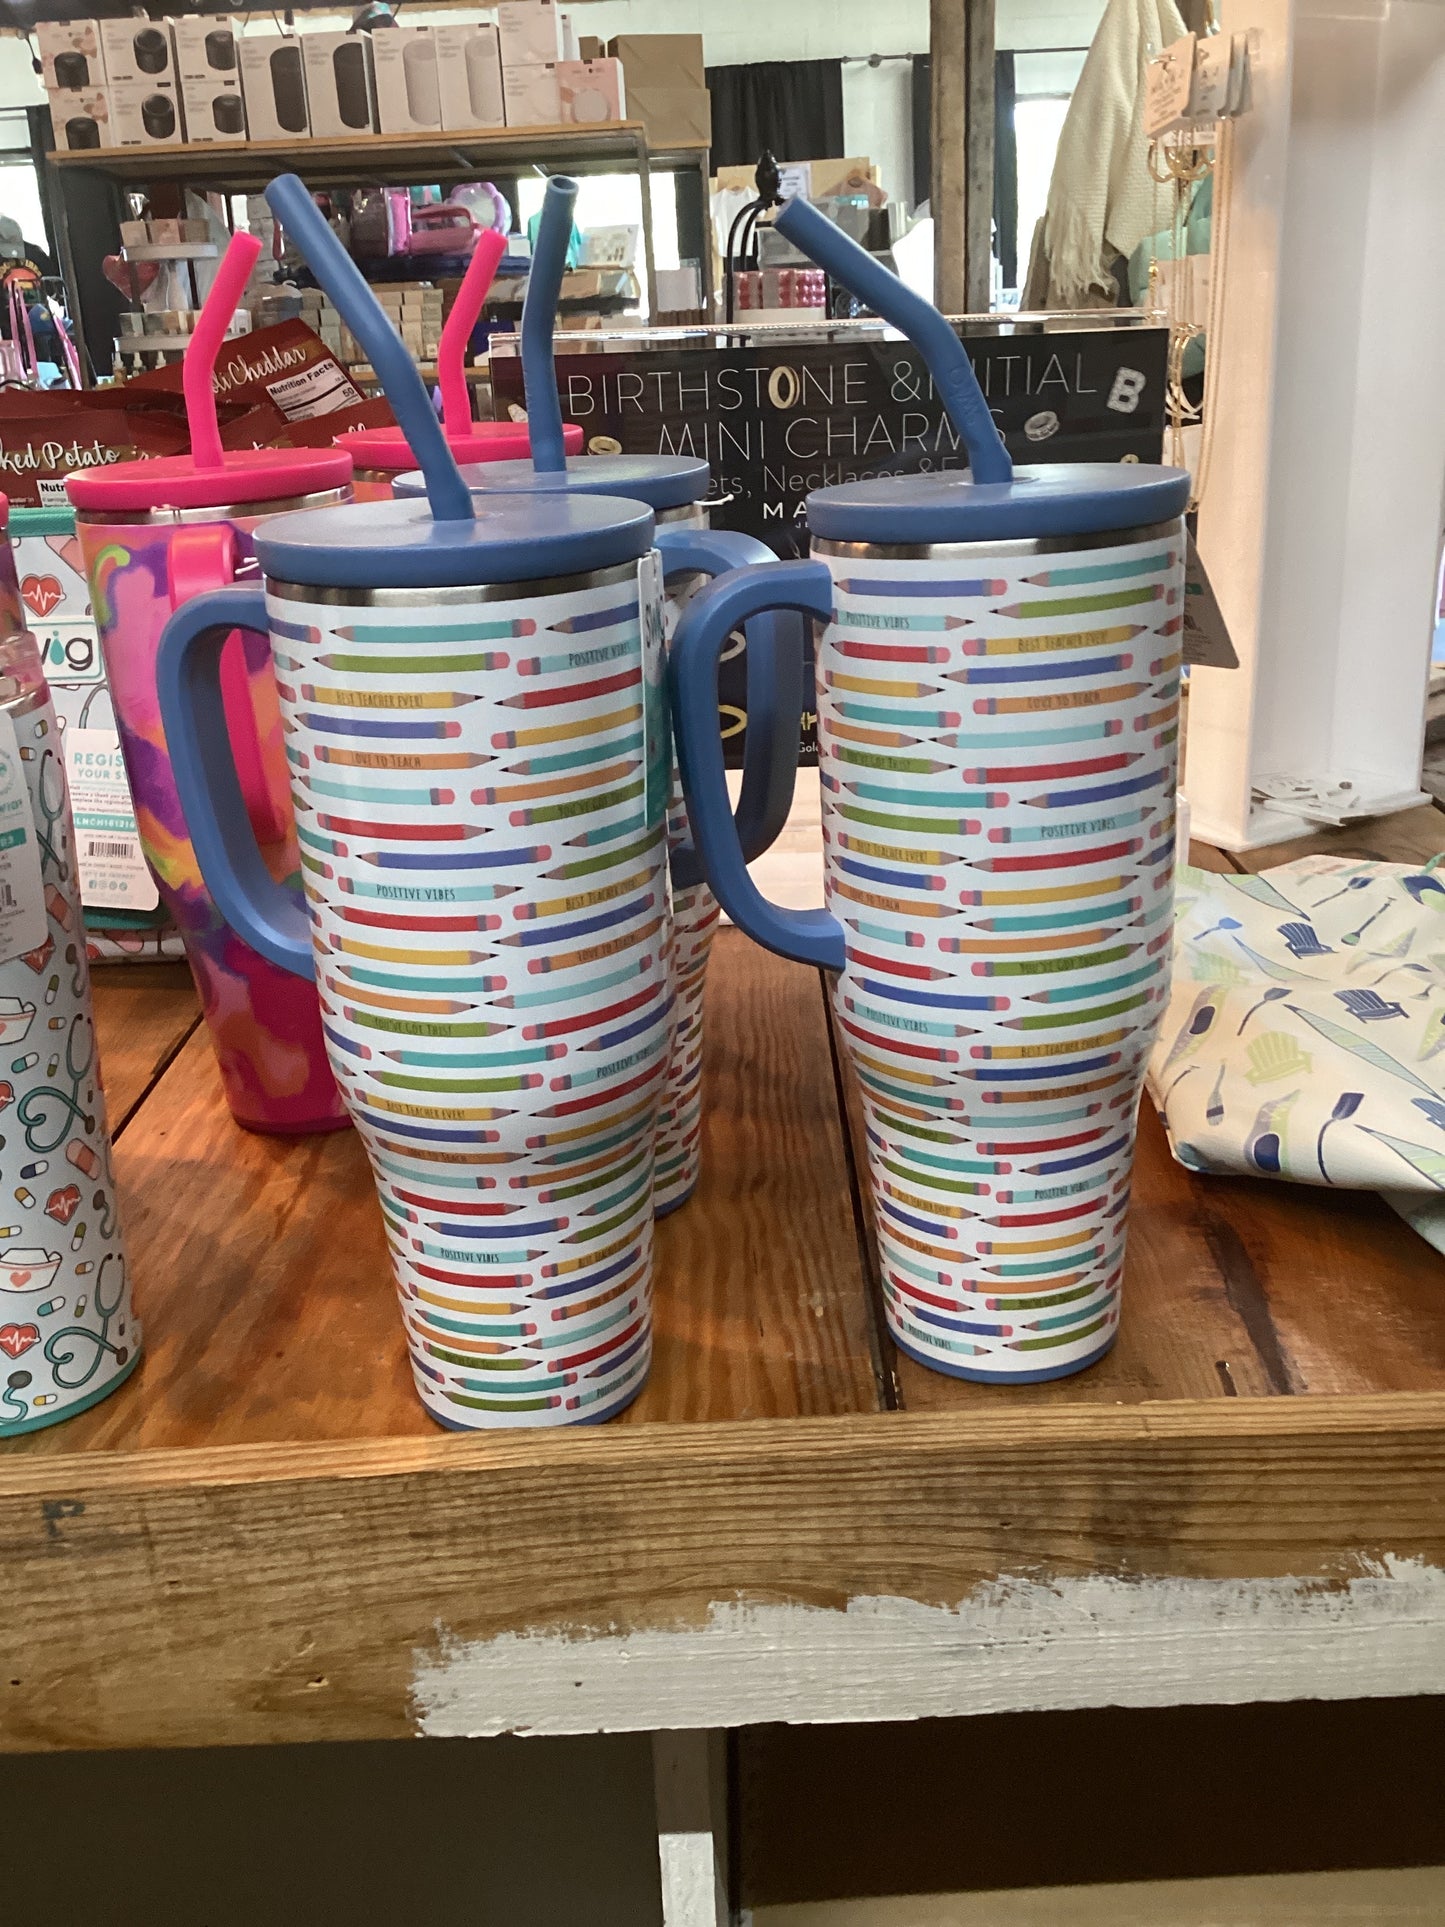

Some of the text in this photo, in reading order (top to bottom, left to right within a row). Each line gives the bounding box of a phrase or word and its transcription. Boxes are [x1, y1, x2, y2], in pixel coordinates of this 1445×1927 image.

[227, 346, 306, 385] Cheddar
[269, 377, 307, 396] Nutrition
[306, 362, 335, 381] Facts
[567, 362, 869, 416] BIRTHSTONE
[890, 360, 921, 402] &
[928, 352, 1098, 400] IITIAL
[657, 420, 765, 461] MINI
[42, 440, 120, 470] Potato
[78, 769, 110, 779] YOUR
[1041, 820, 1087, 839] POSITIVE
[376, 884, 456, 901] POSITIVE VIBES
[903, 1016, 928, 1034] VIBES
[440, 1247, 500, 1263] POSITIVE VIBES
